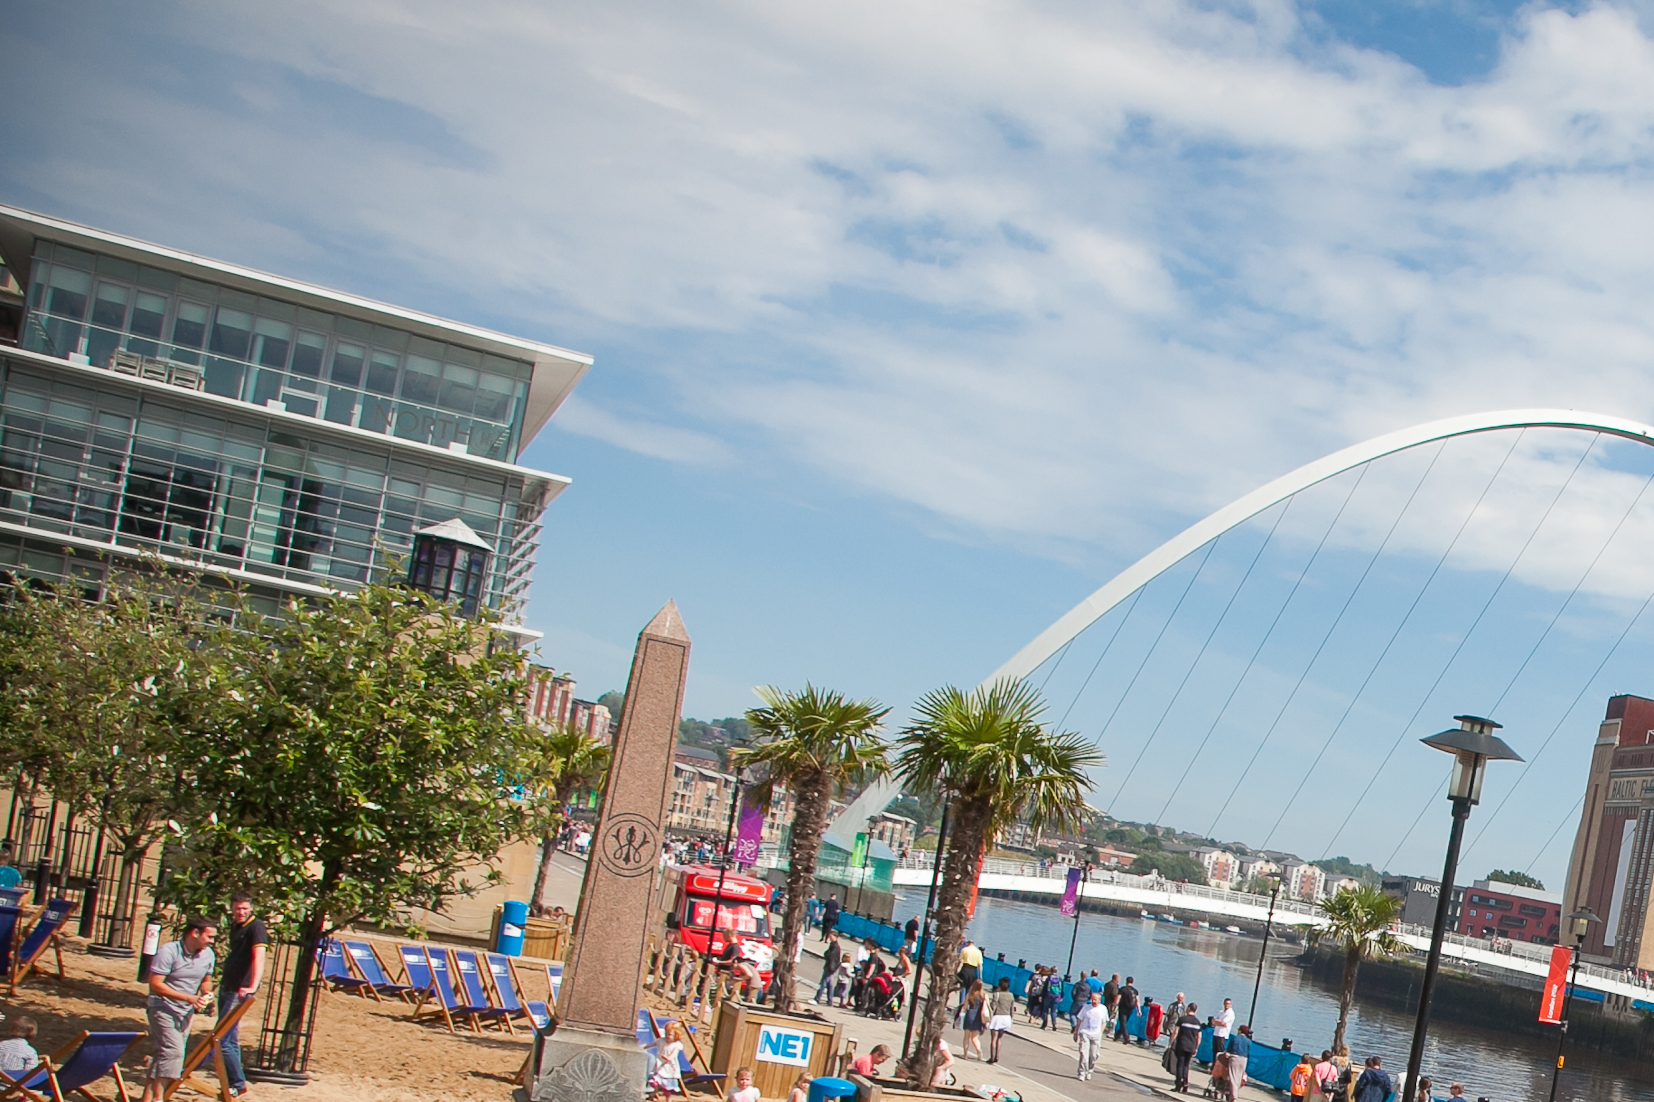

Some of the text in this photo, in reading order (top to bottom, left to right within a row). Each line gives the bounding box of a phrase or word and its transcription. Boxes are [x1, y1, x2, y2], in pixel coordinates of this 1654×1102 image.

[372, 404, 475, 445] NORTH
[1611, 779, 1637, 799] BALTIC
[1413, 881, 1440, 893] JURYS
[1547, 998, 1556, 1019] London
[759, 1030, 810, 1060] NE1
